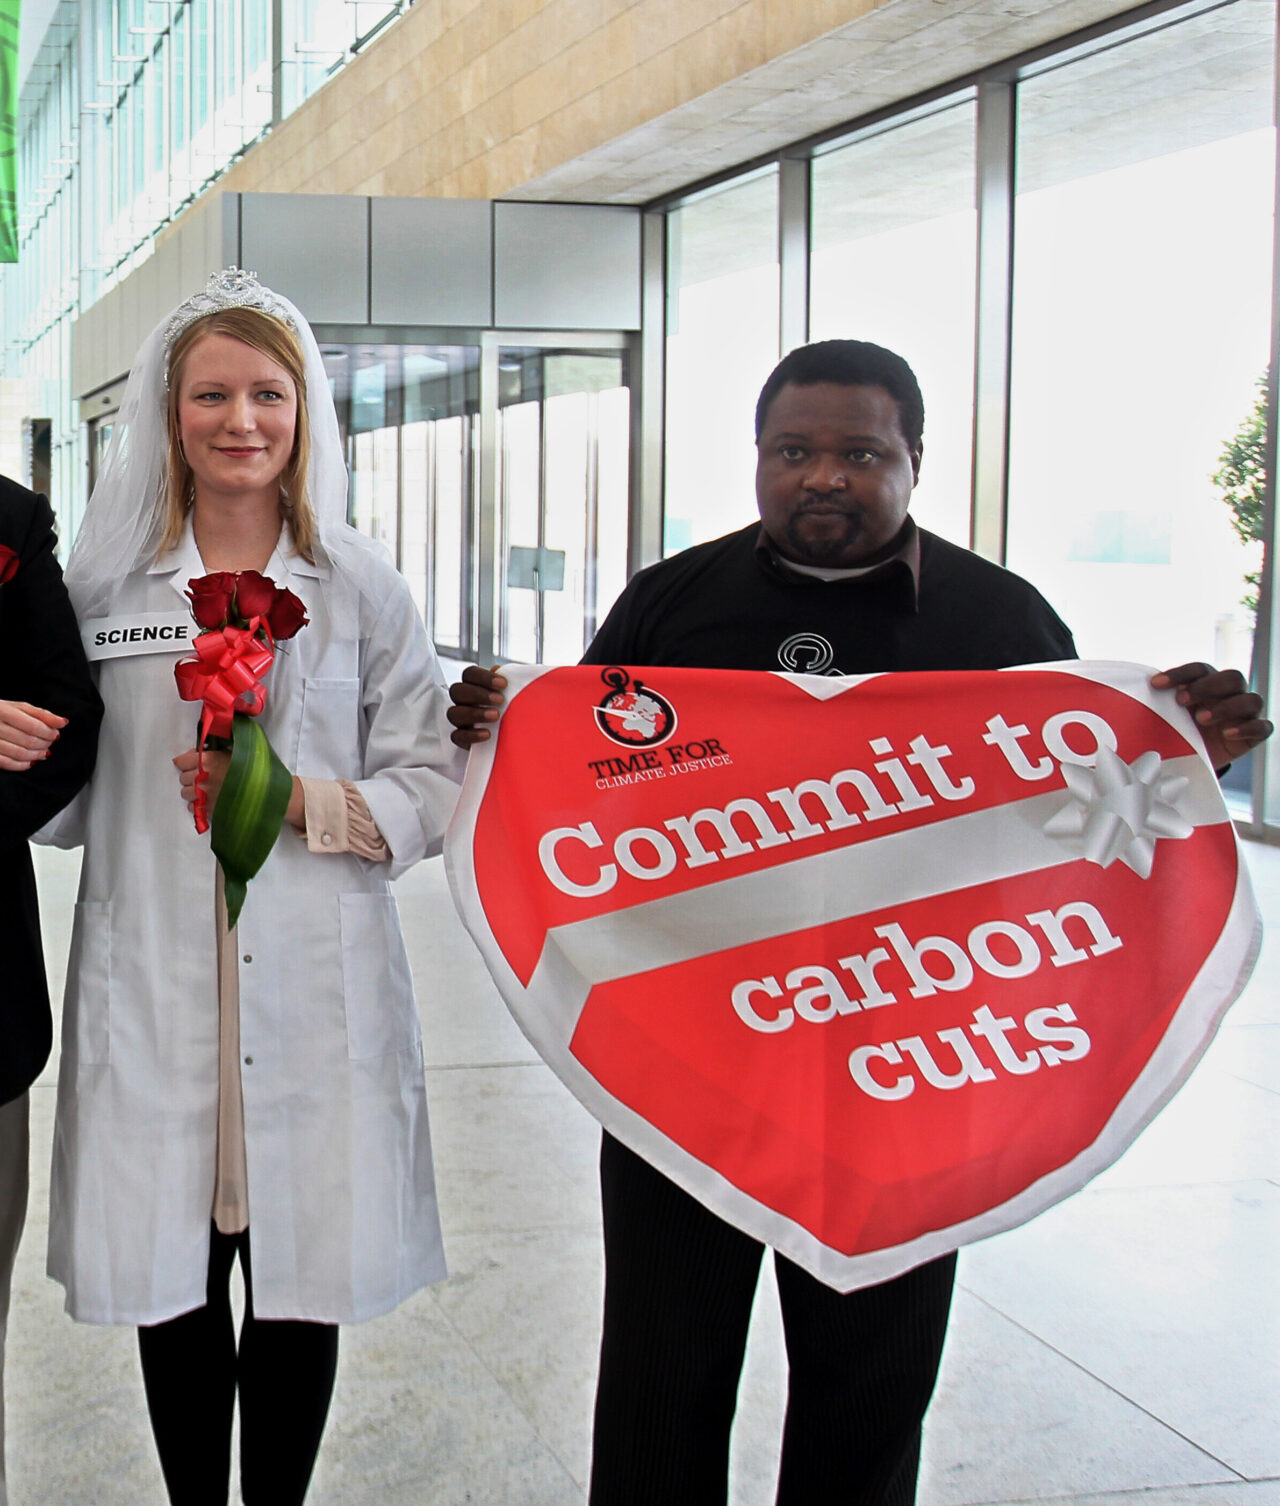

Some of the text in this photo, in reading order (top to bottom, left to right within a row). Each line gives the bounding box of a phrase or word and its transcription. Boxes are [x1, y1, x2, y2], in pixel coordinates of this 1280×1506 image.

[95, 626, 188, 646] SCIENCE
[588, 738, 728, 779] TIME FOR
[595, 754, 733, 790] CLIMATE JUSTICE
[538, 710, 1118, 898] Commit to
[731, 901, 1124, 1034] carbon
[848, 1002, 1091, 1101] cuts
